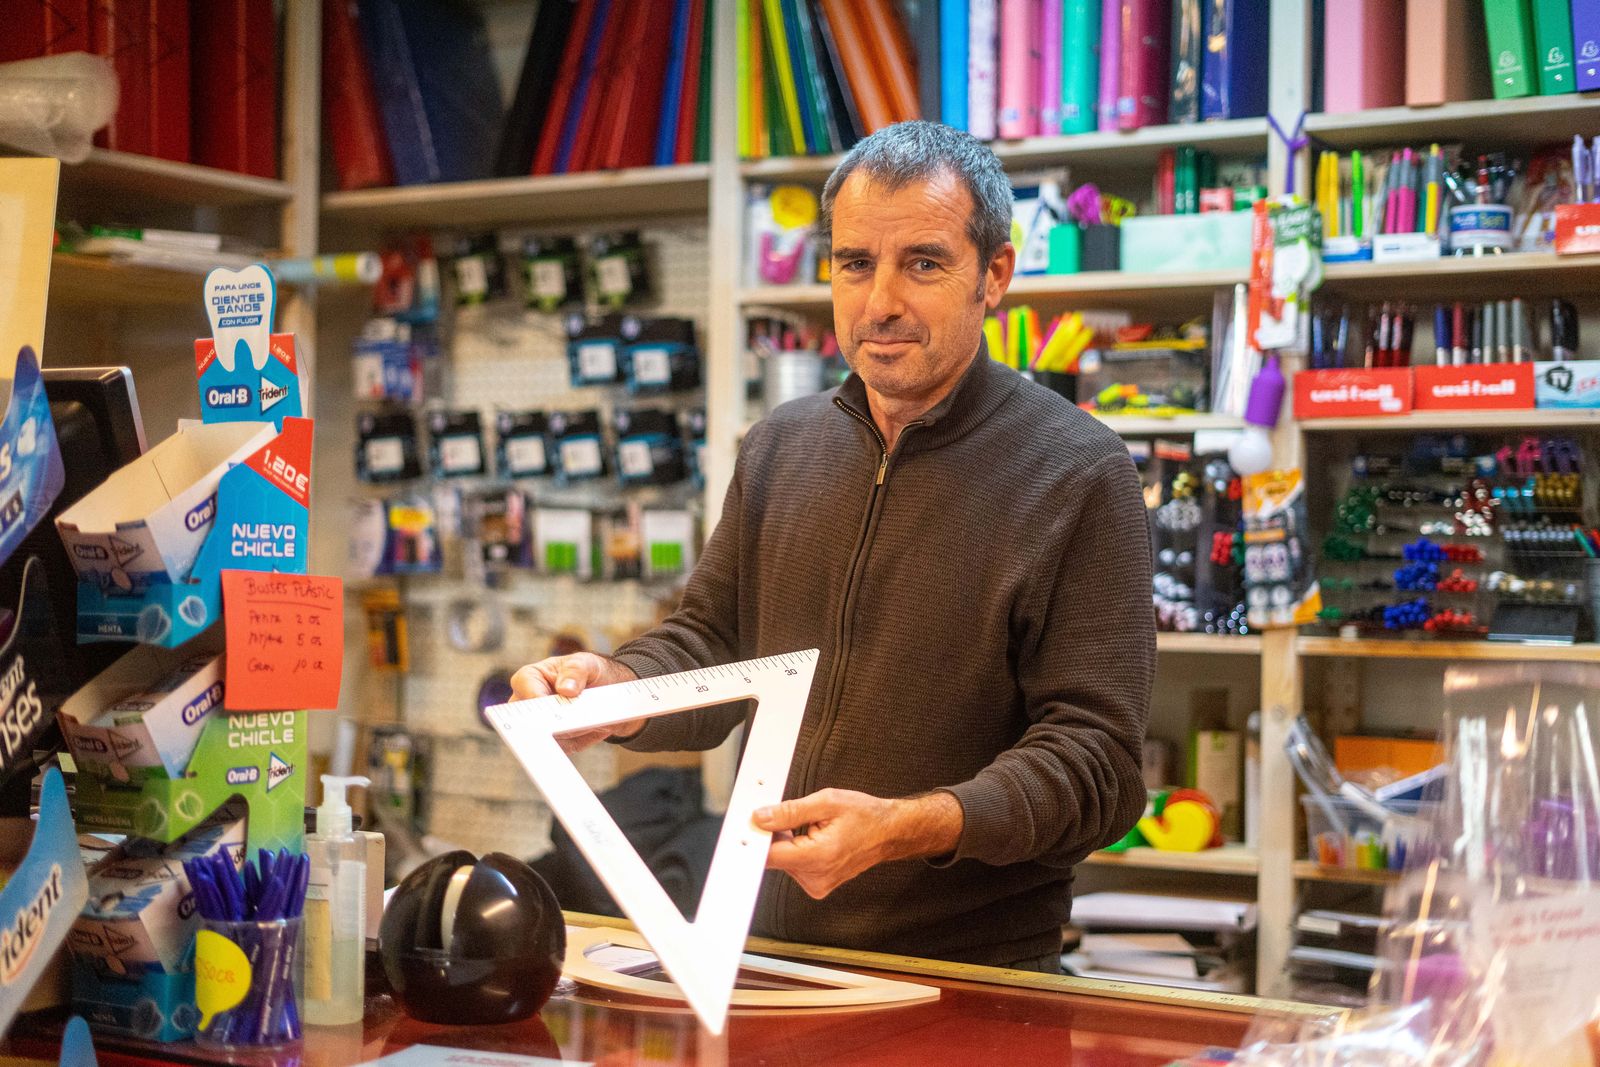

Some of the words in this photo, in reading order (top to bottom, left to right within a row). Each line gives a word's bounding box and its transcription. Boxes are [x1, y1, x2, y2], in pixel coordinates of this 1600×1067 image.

[214, 284, 237, 292] PARA
[238, 282, 262, 290] UNOS
[211, 293, 265, 306] DIENTES
[217, 303, 261, 314] SANOS
[221, 318, 235, 326] CON
[208, 388, 249, 405] Oral-B
[257, 384, 290, 402] Trident
[232, 523, 296, 540] NUEVO
[231, 541, 295, 557] CHICLE
[696, 685, 709, 693] 20
[743, 676, 752, 684] 5
[784, 668, 798, 676] 30
[229, 711, 295, 729] NUEVO
[228, 728, 294, 748] CHICLE
[266, 763, 294, 779] Trident
